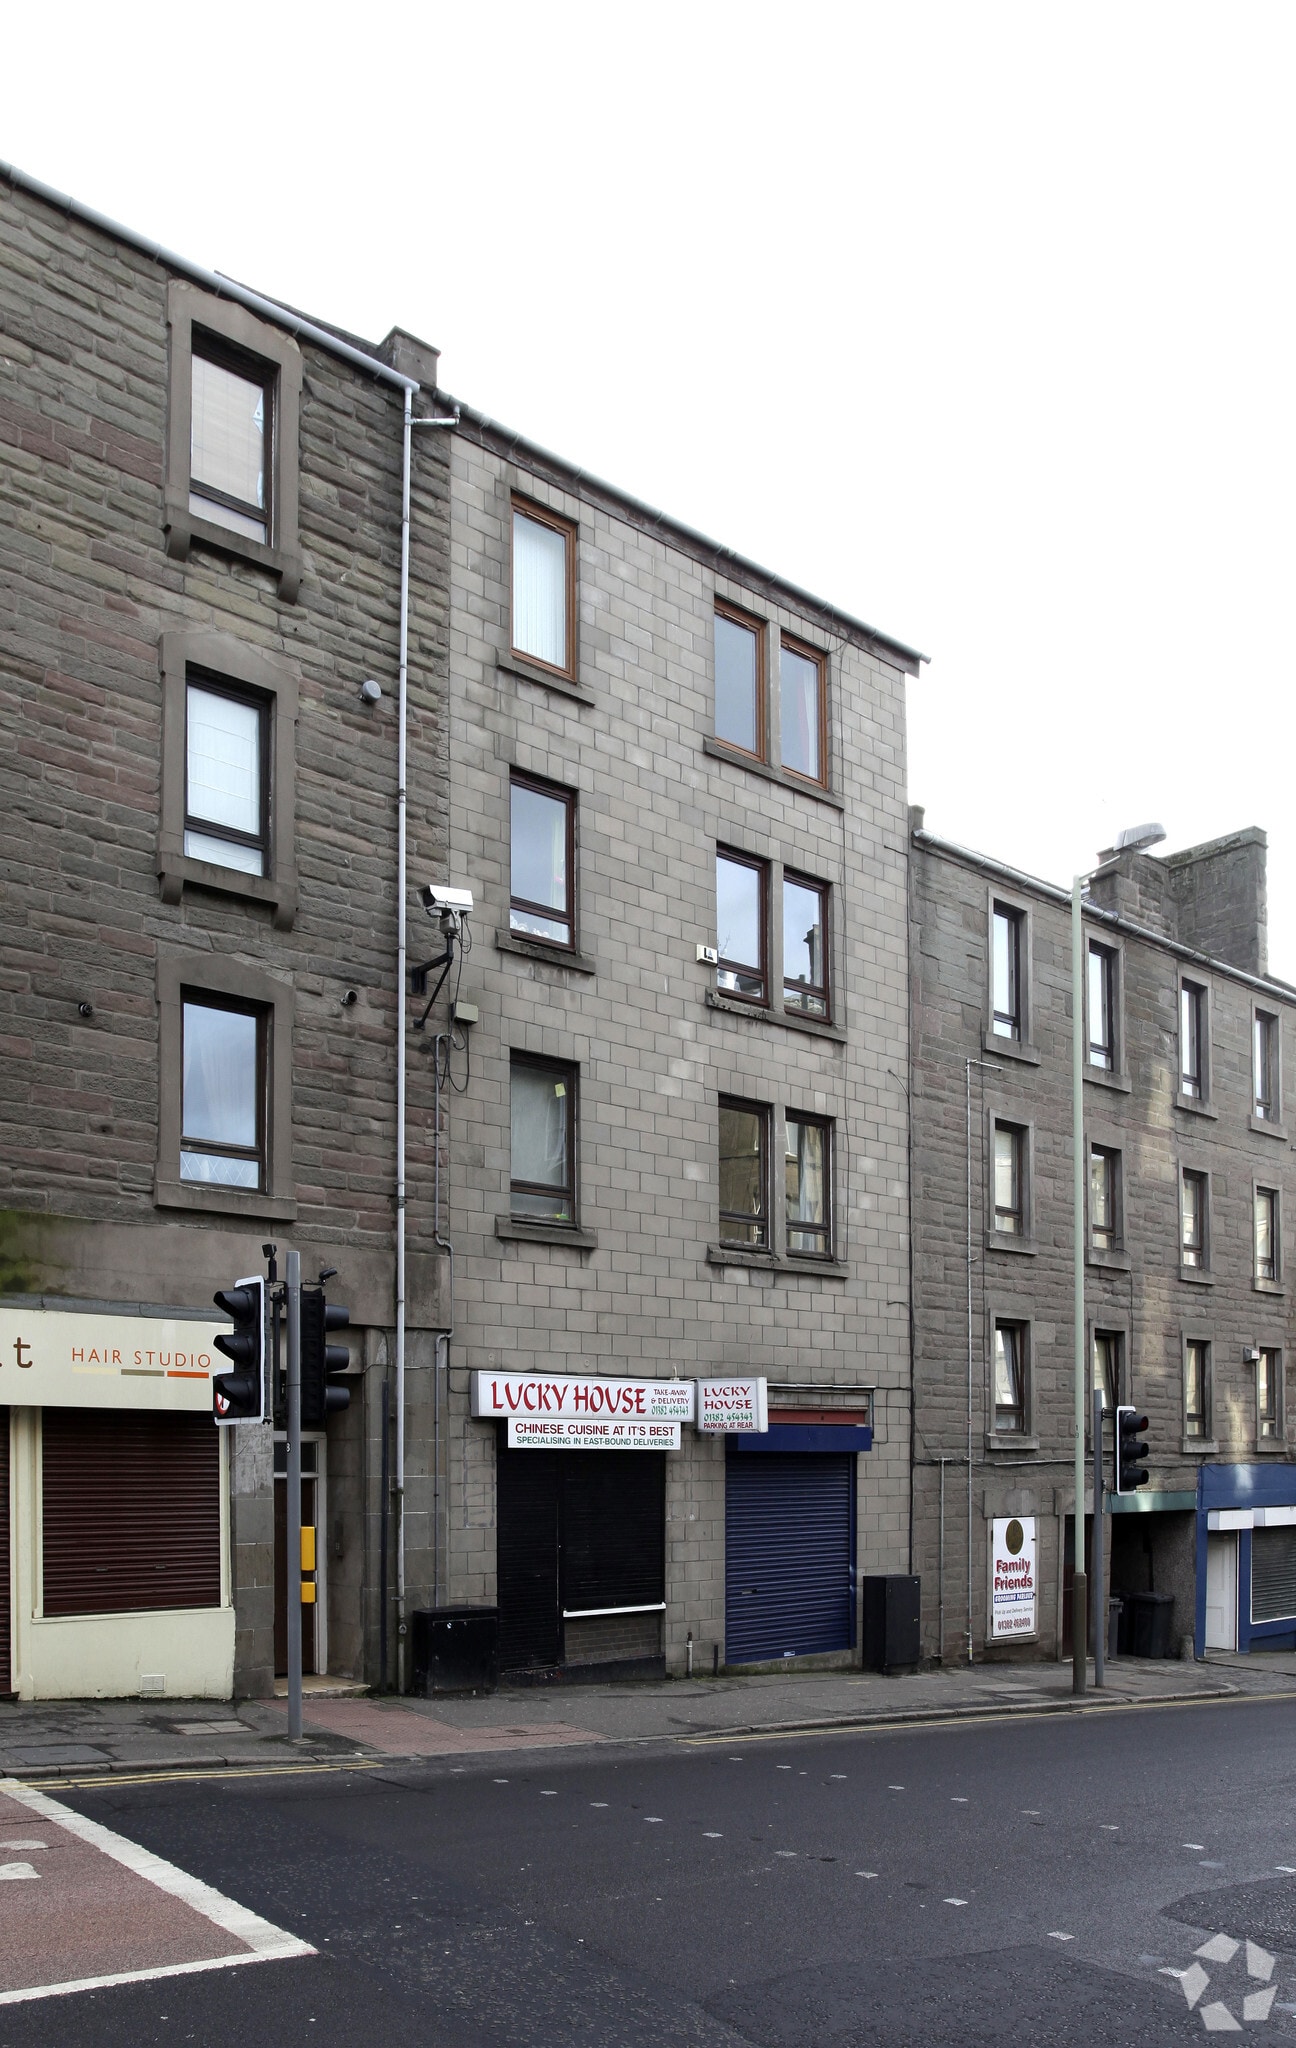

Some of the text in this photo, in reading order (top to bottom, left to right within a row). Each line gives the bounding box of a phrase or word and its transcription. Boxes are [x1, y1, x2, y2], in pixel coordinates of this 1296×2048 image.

[71, 1347, 211, 1368] HAIR STUDIO
[653, 1388, 688, 1396] TAKE-AWAY
[703, 1385, 751, 1397] LUCKY
[491, 1380, 647, 1414] LUCKY HOUSE
[650, 1397, 690, 1405] & DELIVERY
[703, 1399, 753, 1410] HOUSE
[651, 1405, 689, 1416] 01382 454343
[703, 1412, 753, 1422] 01382 454343
[515, 1422, 675, 1437] CHINESE CUISINE AT IT'S BEST
[737, 1421, 753, 1429] REAR
[516, 1436, 674, 1447] SPECIALISING IN EAST-BOUND DELIVERIES
[996, 1557, 1031, 1575] Family
[994, 1574, 1033, 1591] Friends
